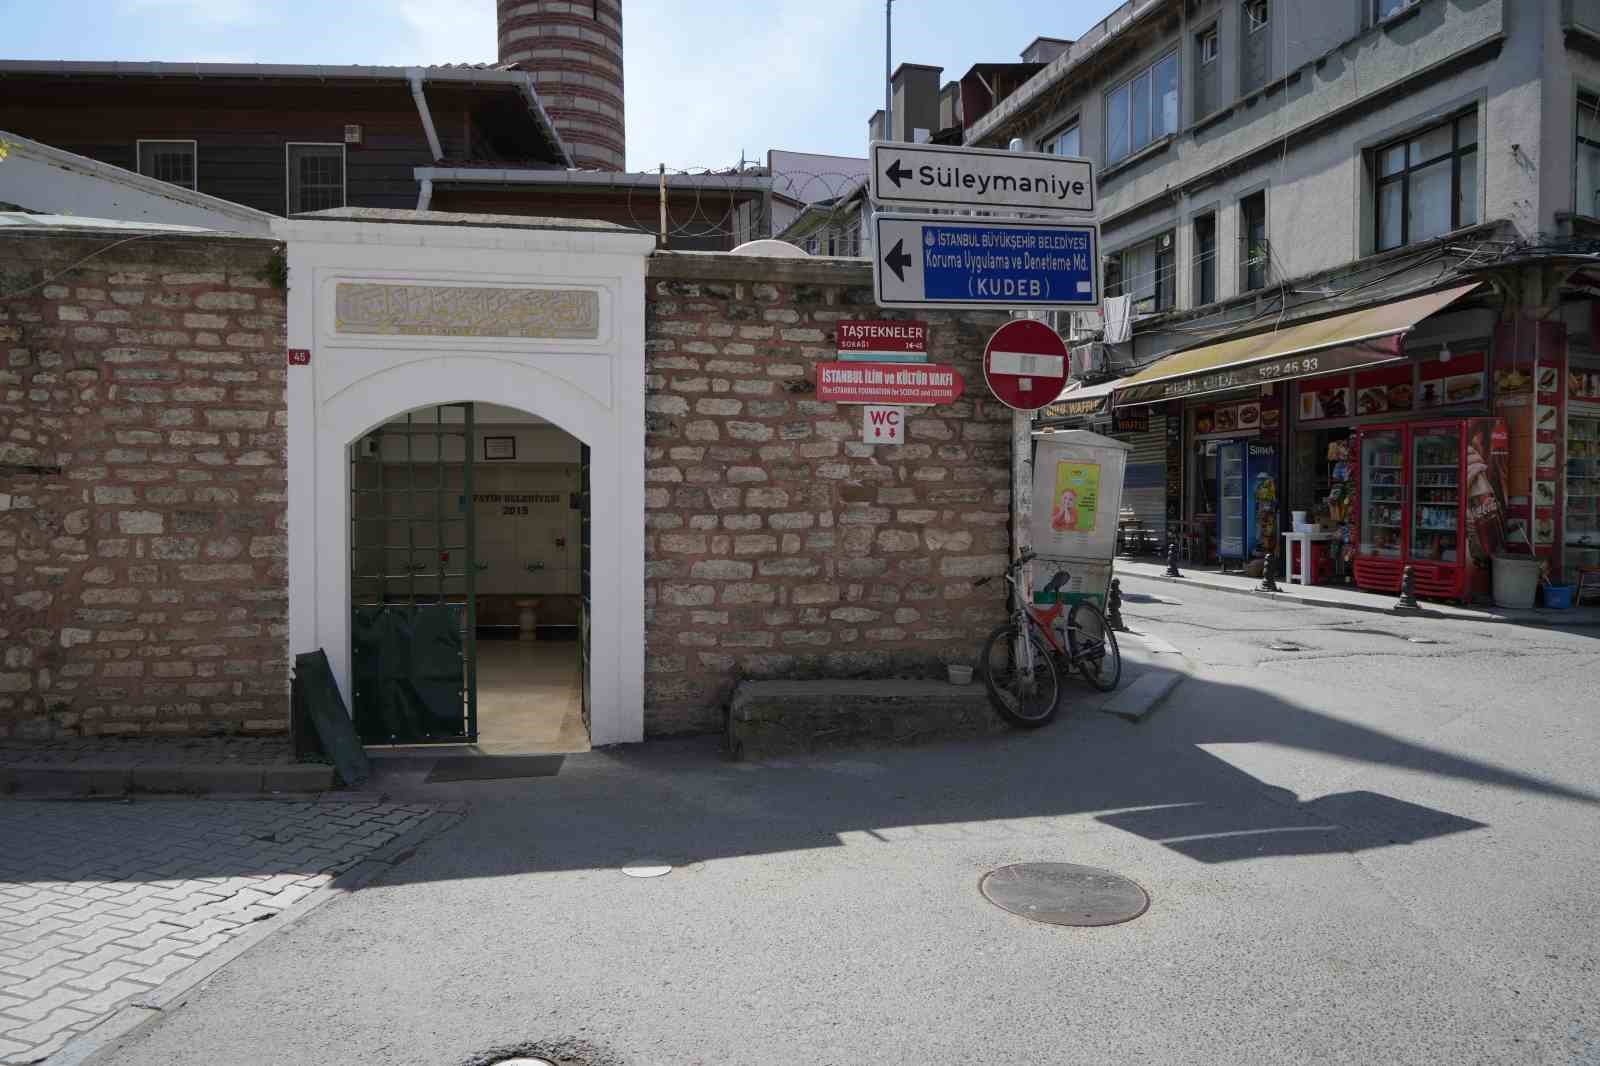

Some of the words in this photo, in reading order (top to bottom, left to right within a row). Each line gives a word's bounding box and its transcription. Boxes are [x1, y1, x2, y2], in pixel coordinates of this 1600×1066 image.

[920, 165, 1085, 199] Süleymaniye
[938, 231, 980, 247] İSTANBUL
[982, 231, 1035, 250] BÜYÜKŞEHİR
[1038, 233, 1087, 250] BELEDİYESİ
[926, 251, 962, 268] Koruma
[964, 252, 1010, 273] Uygulama
[1012, 257, 1022, 270] ve
[1024, 252, 1071, 270] Denetleme
[1073, 254, 1088, 271] Md.
[841, 325, 923, 339] TAŞTEKNELER
[822, 367, 864, 383] İSTANBUL
[884, 373, 895, 384] ve
[897, 369, 928, 385] KÜLTÜR
[929, 372, 953, 386] VAKFI
[1259, 365, 1280, 378] 522
[1302, 357, 1318, 370] 93
[871, 411, 899, 425] WC
